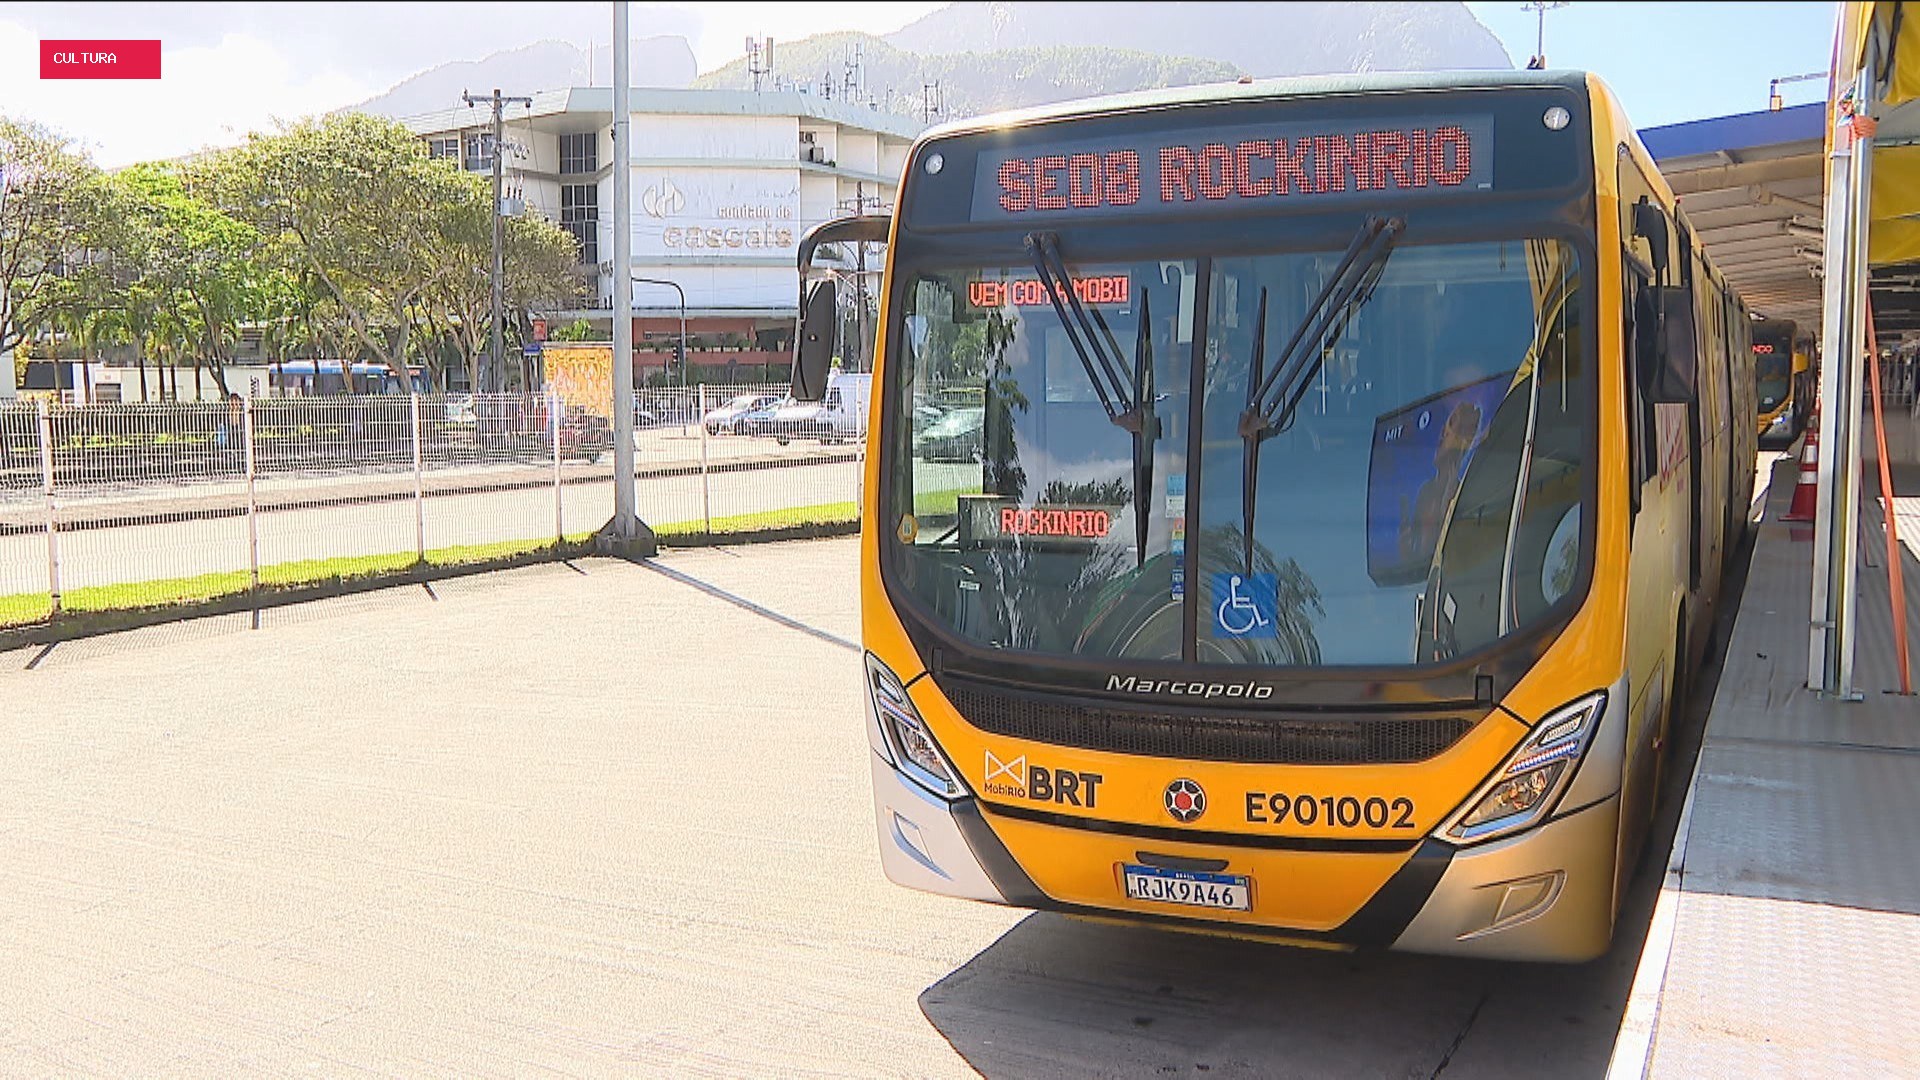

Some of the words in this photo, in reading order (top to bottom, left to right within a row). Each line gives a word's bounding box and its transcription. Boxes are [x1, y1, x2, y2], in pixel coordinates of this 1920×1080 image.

[1160, 125, 1472, 202] ROCKINRIO
[663, 221, 793, 248] cascais
[969, 282, 1008, 307] VEM
[1001, 509, 1109, 537] ROCKINRIO
[1106, 674, 1273, 699] Marcopolo
[984, 783, 1026, 798] MobiRIO
[1029, 765, 1103, 808] BRT
[1246, 791, 1415, 828] E901002
[1137, 876, 1234, 906] RJK9A46
